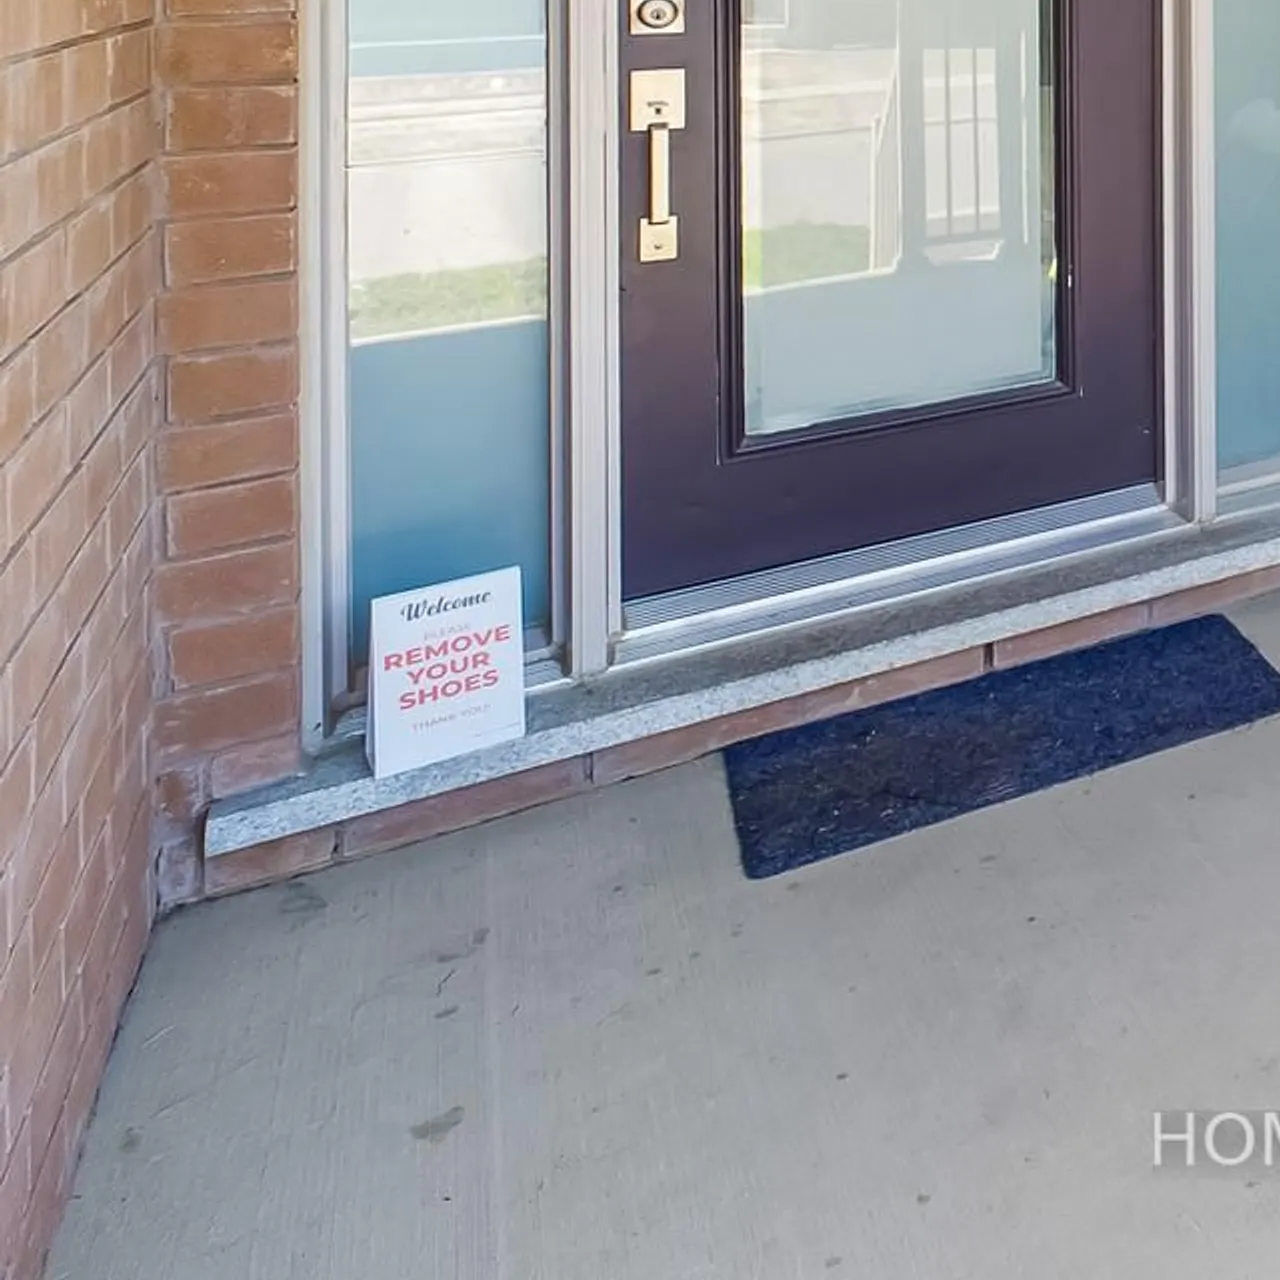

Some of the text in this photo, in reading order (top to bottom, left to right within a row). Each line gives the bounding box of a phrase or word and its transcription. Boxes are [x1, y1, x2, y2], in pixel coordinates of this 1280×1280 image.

[400, 592, 491, 621] Welcome
[384, 624, 510, 671] REMOVE
[407, 651, 490, 684] YOUR
[400, 669, 498, 710] SHOES
